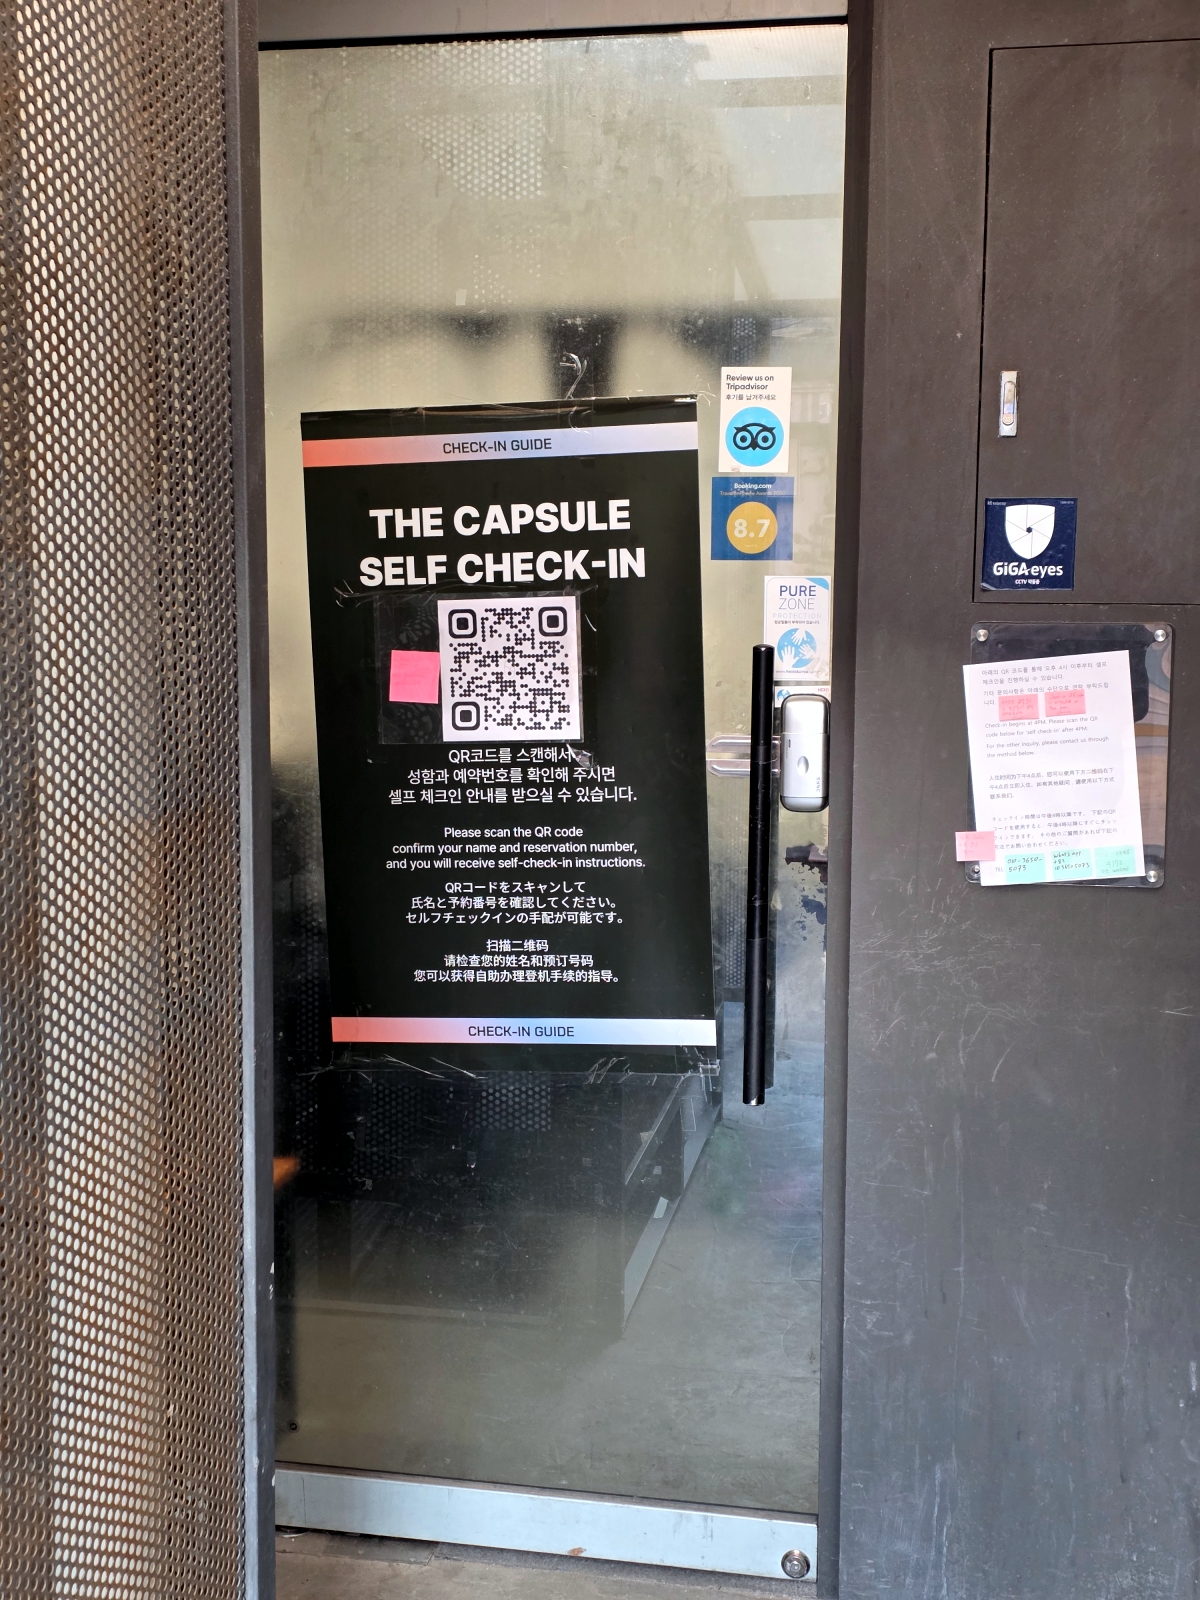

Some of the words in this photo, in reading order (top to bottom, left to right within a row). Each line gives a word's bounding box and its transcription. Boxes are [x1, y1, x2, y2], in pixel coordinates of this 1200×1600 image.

[726, 383, 768, 392] Tripadvisor
[442, 439, 508, 454] CHECK-IN
[510, 438, 552, 452] GUIDE
[368, 506, 444, 539] THE
[453, 498, 631, 536] CAPSULE
[734, 518, 770, 538] 8.7
[360, 554, 447, 587] SELF
[456, 547, 646, 584] CHECK-IN
[780, 586, 816, 596] PURE
[778, 598, 815, 610] ZONE
[1042, 739, 1058, 747] please
[448, 747, 512, 764] QR코드를
[516, 746, 572, 763] 스캔해서
[408, 768, 450, 784] 성함과
[453, 767, 524, 784] 예약번호를
[526, 766, 569, 783] 확인해
[572, 766, 616, 782] 주시면
[388, 788, 416, 805] 셀프
[420, 788, 462, 804] 체크인
[466, 788, 508, 804] 안내를
[512, 787, 553, 804] 받으실
[558, 786, 572, 803] 수
[576, 786, 638, 803] 있습니다.
[444, 827, 481, 838] Please
[484, 829, 510, 838] scan
[513, 827, 532, 838] the
[534, 827, 552, 838] QR
[554, 826, 584, 838] code
[392, 843, 435, 854] confirm
[438, 845, 462, 857] your
[466, 845, 496, 854] name
[499, 842, 520, 854] and
[523, 842, 587, 854] reservation
[590, 842, 638, 854] number,
[386, 858, 407, 870] and
[410, 860, 430, 872] you
[433, 858, 452, 869] will
[454, 858, 495, 869] receive
[498, 858, 573, 868] self-check-in
[575, 857, 646, 868] instructions.
[444, 881, 586, 894] QRコードをスキャンして
[412, 896, 618, 910] 氏名と予約番号を確認してください。
[406, 912, 624, 924] セルフチェックインの手配が可能です。
[486, 940, 549, 952] 扫描二维码
[444, 954, 594, 968] 请检查您的姓名和预订号码
[414, 970, 620, 983] 您可以获得自助办理登机手续的指导。
[468, 1026, 531, 1038] CHECK-IN
[534, 1026, 575, 1038] GUIDE
